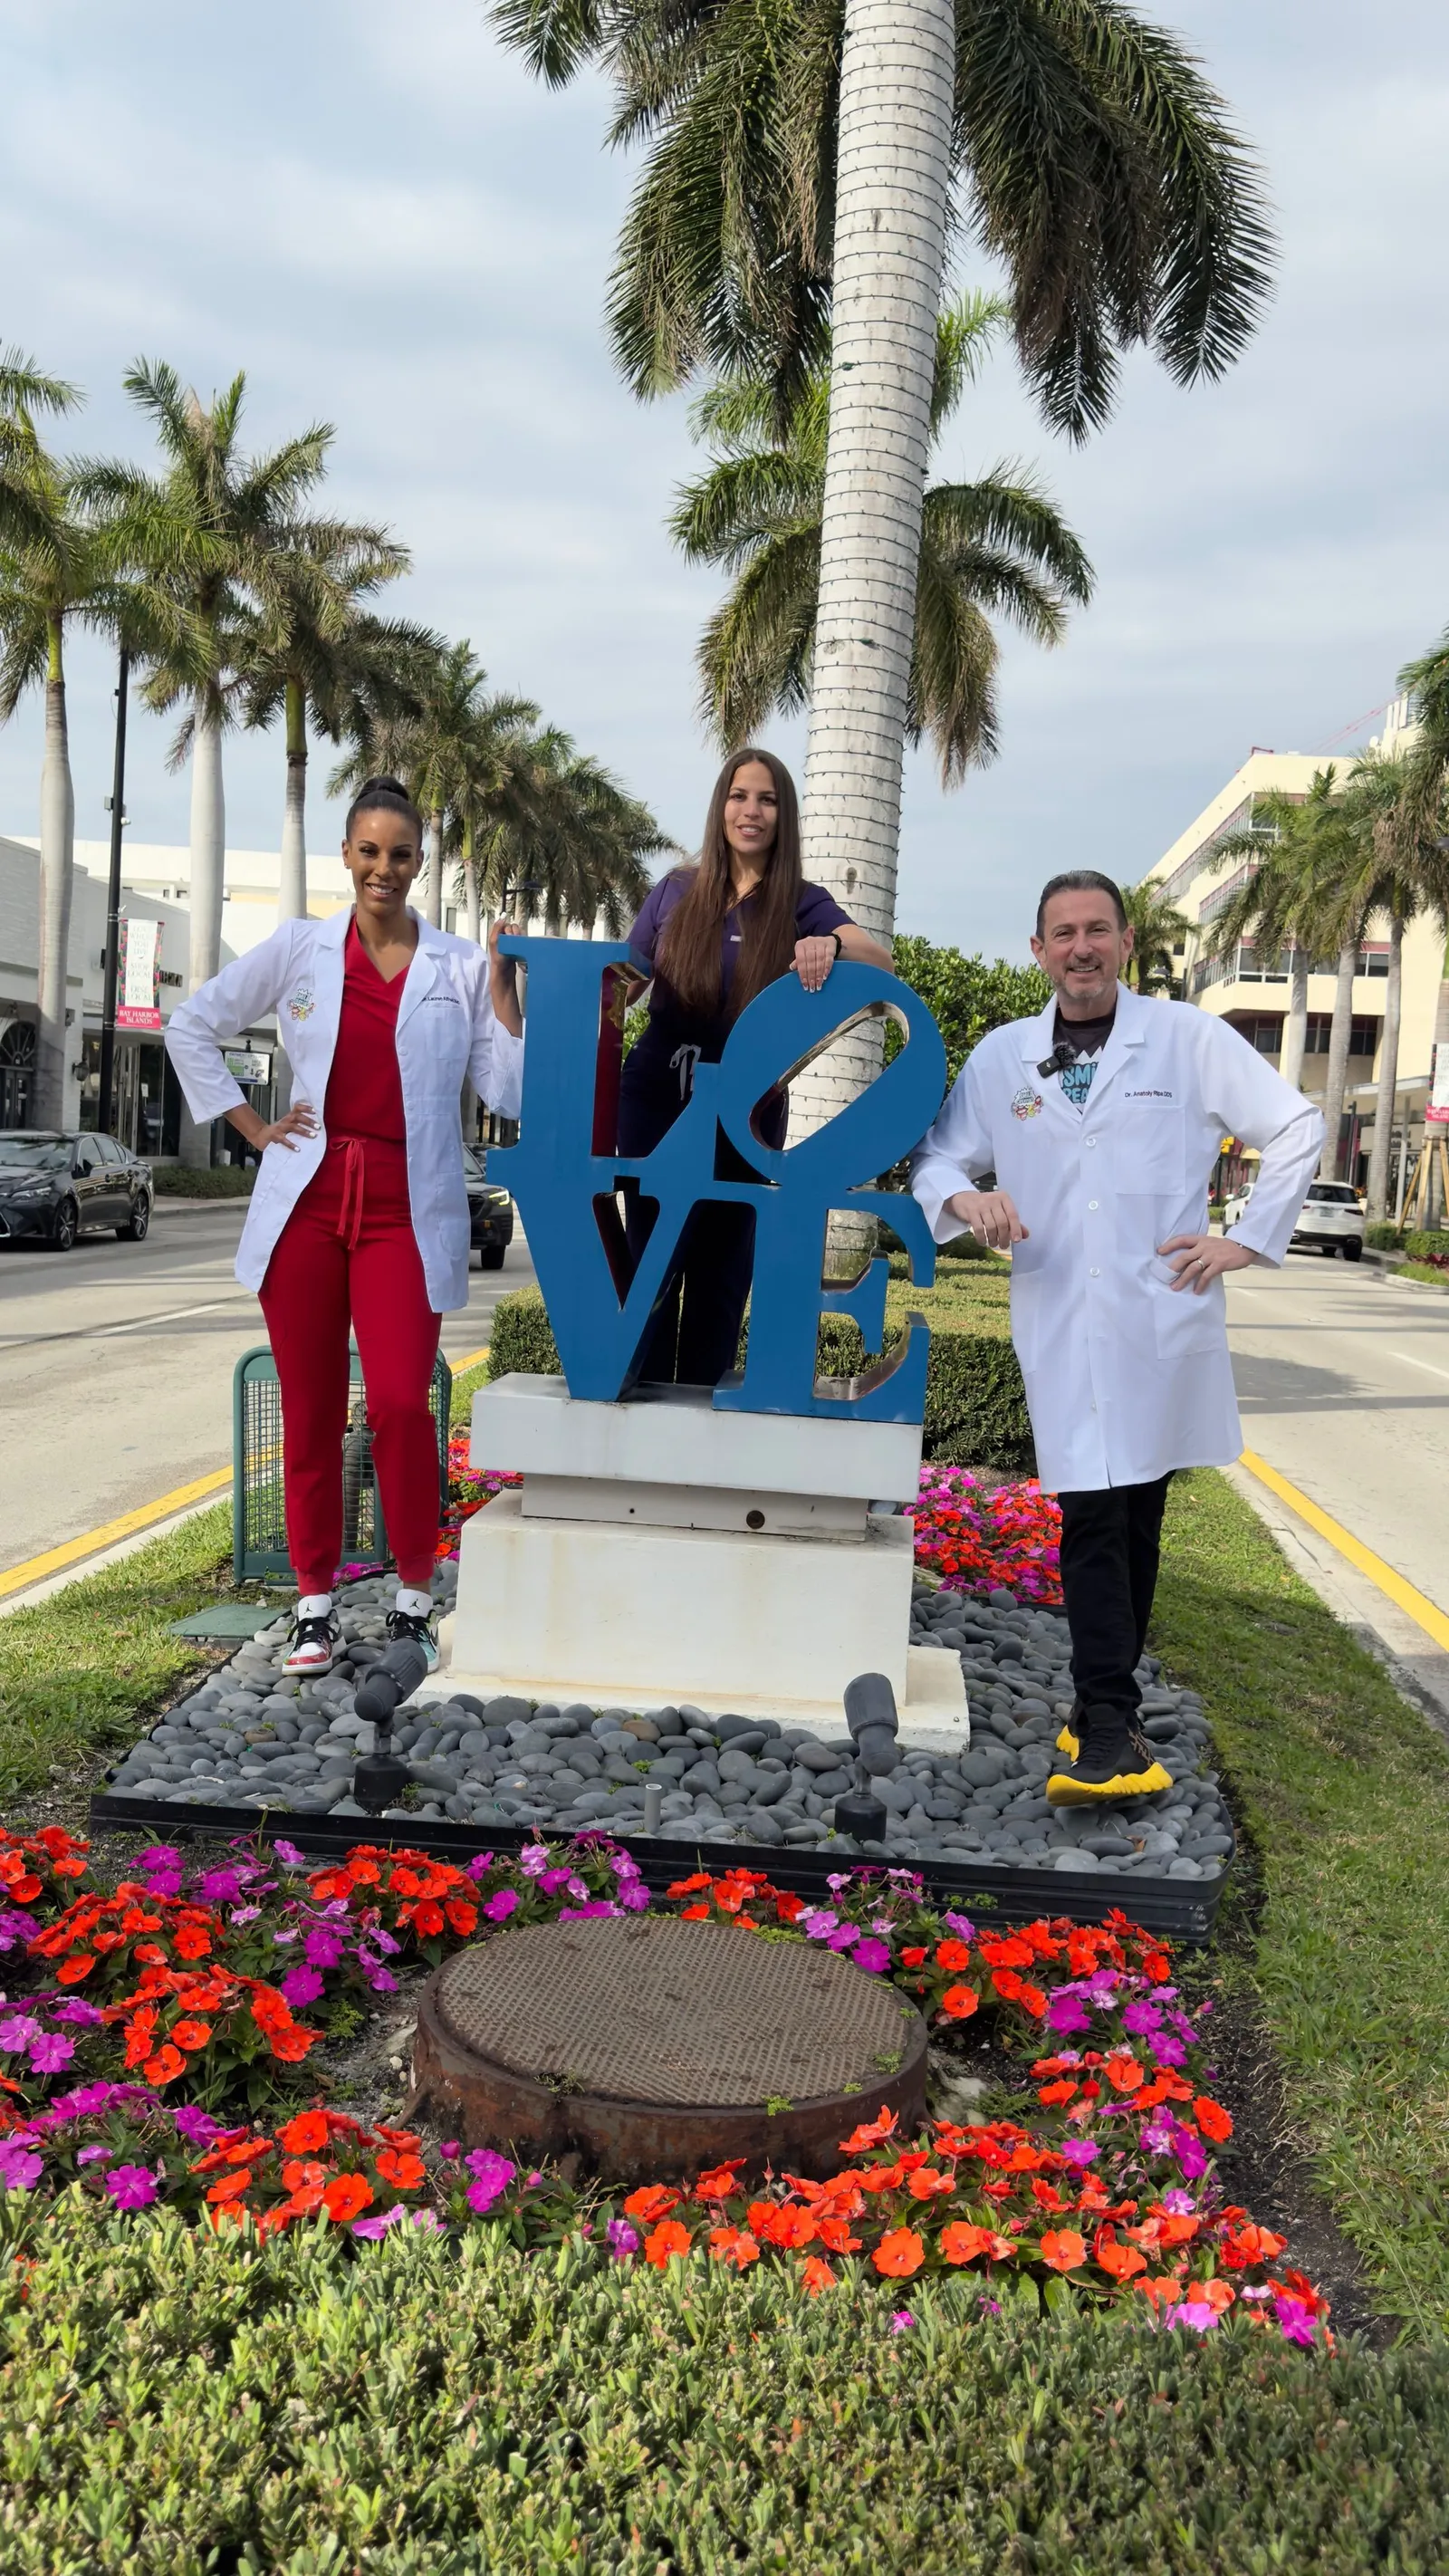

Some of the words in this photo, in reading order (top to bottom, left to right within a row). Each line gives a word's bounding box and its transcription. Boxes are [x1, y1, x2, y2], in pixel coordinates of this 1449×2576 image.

[132, 1010, 159, 1019] HARBOR
[126, 1016, 153, 1024] ISLANDS
[1063, 1062, 1098, 1087] SMi
